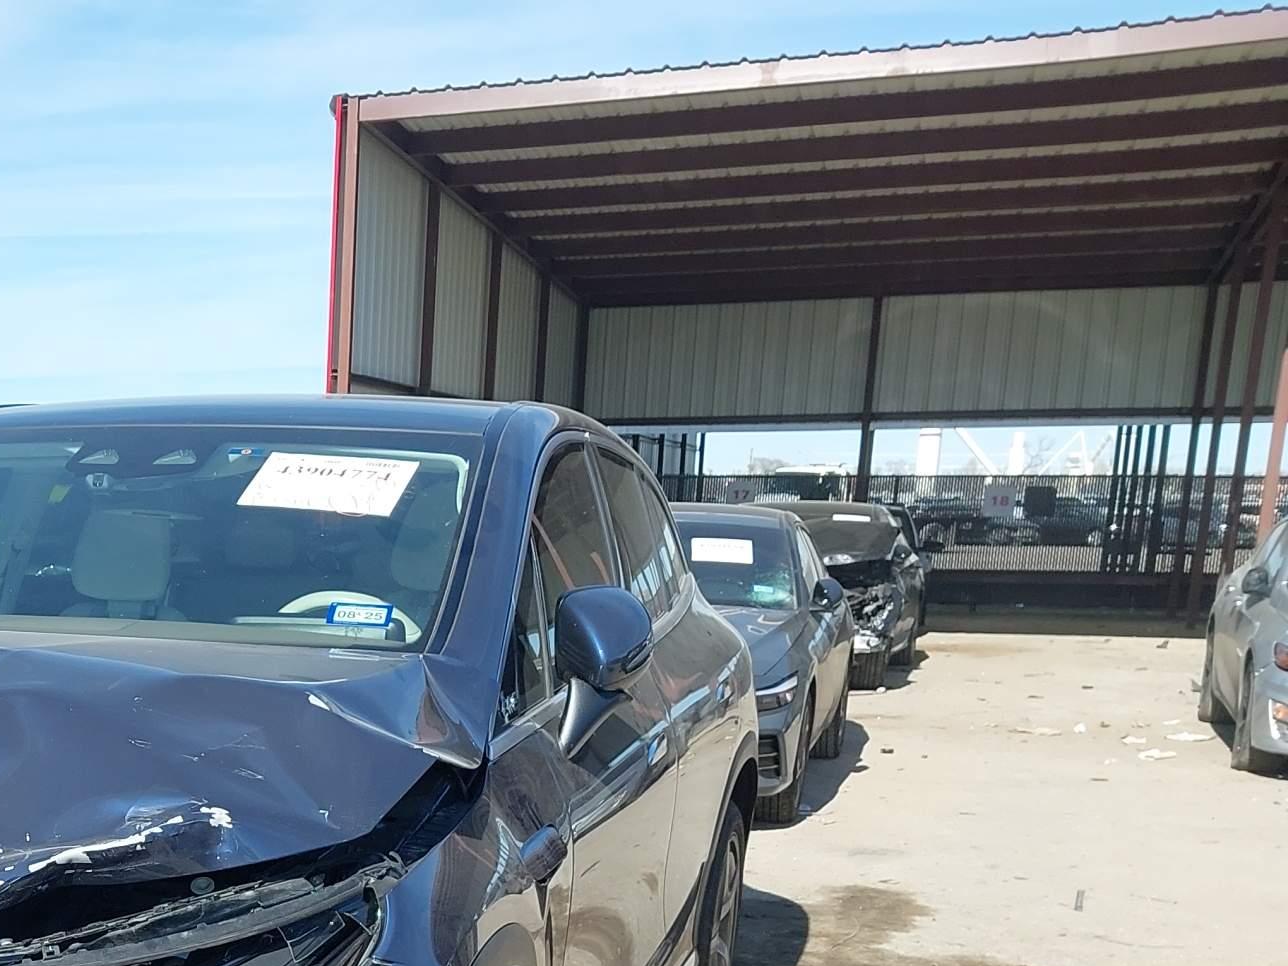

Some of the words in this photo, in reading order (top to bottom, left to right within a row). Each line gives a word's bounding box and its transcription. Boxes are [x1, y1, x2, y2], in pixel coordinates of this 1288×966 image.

[733, 489, 750, 500] 17
[992, 495, 1010, 507] 18
[337, 610, 357, 619] 08
[364, 612, 383, 621] 25
